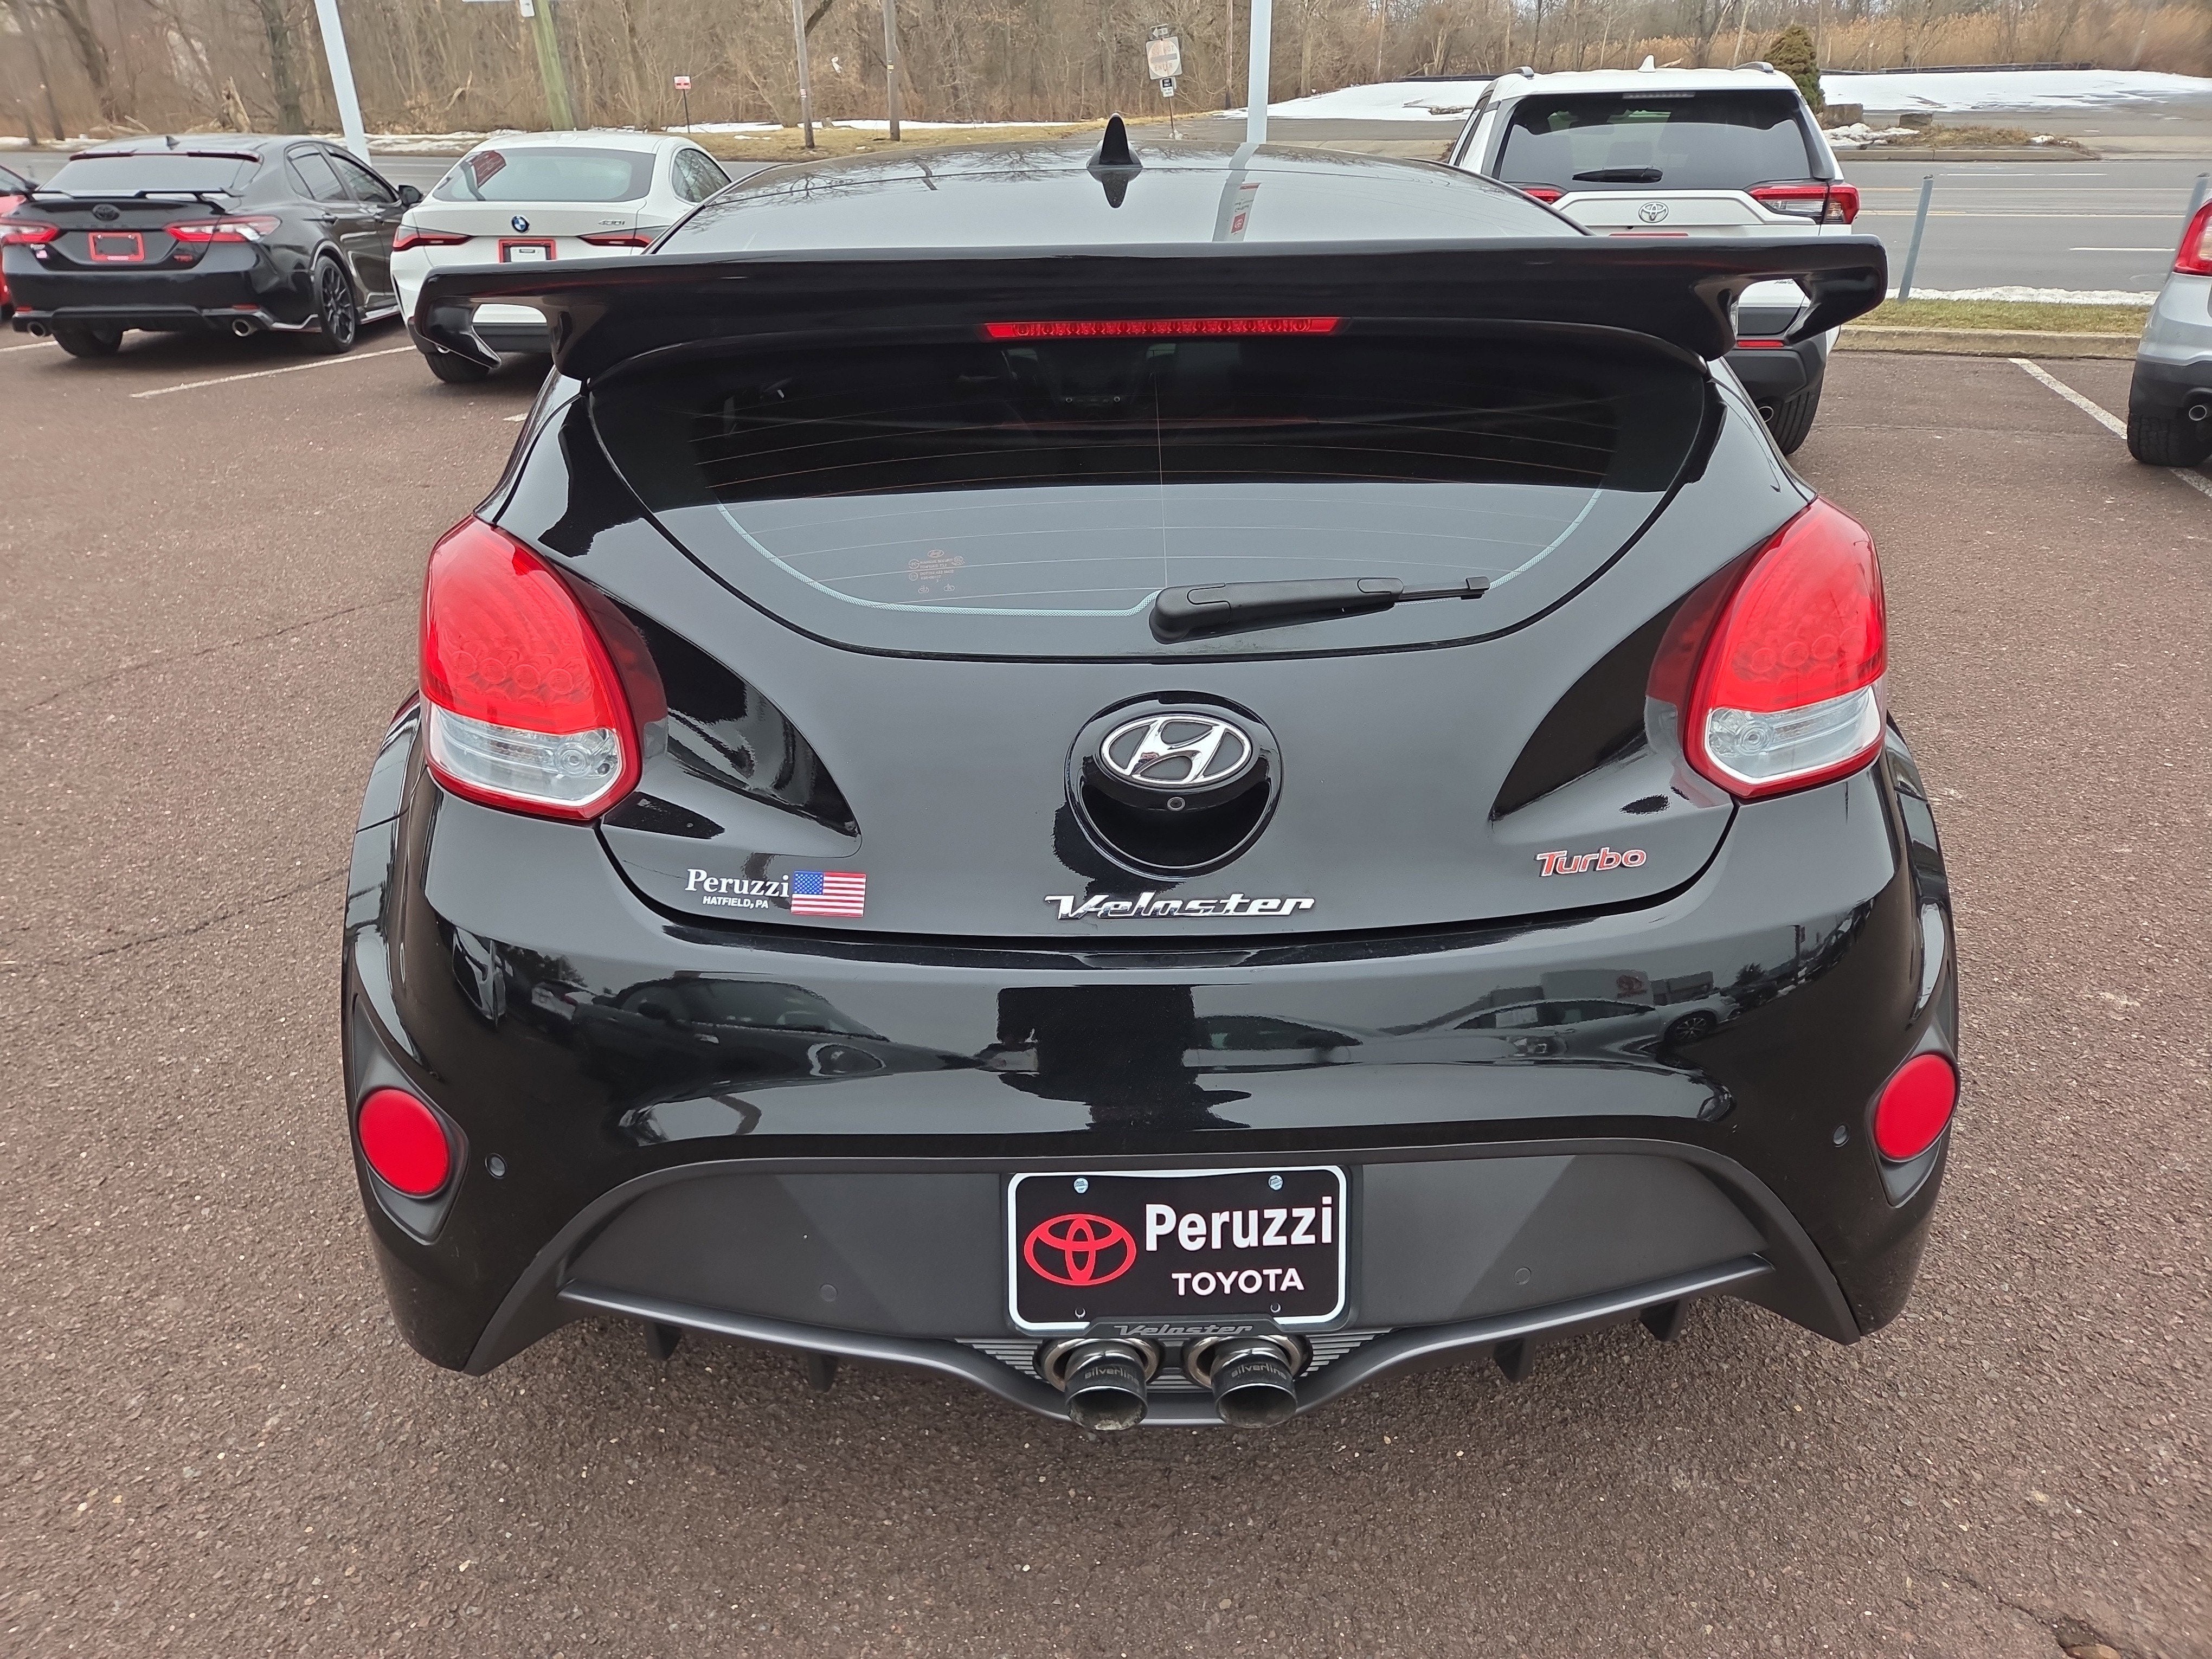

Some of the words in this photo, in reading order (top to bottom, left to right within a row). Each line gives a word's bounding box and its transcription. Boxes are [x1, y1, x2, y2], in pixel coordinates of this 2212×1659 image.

[1536, 846, 1647, 877] Turbo
[684, 868, 790, 898] Peruzzi
[702, 895, 755, 909] HATFIELD,
[755, 899, 769, 909] PA
[1044, 891, 1315, 920] Veloster
[1144, 1197, 1333, 1252] Peruzzi
[1171, 1268, 1305, 1296] TOYOTA
[1113, 1324, 1253, 1336] Veloster
